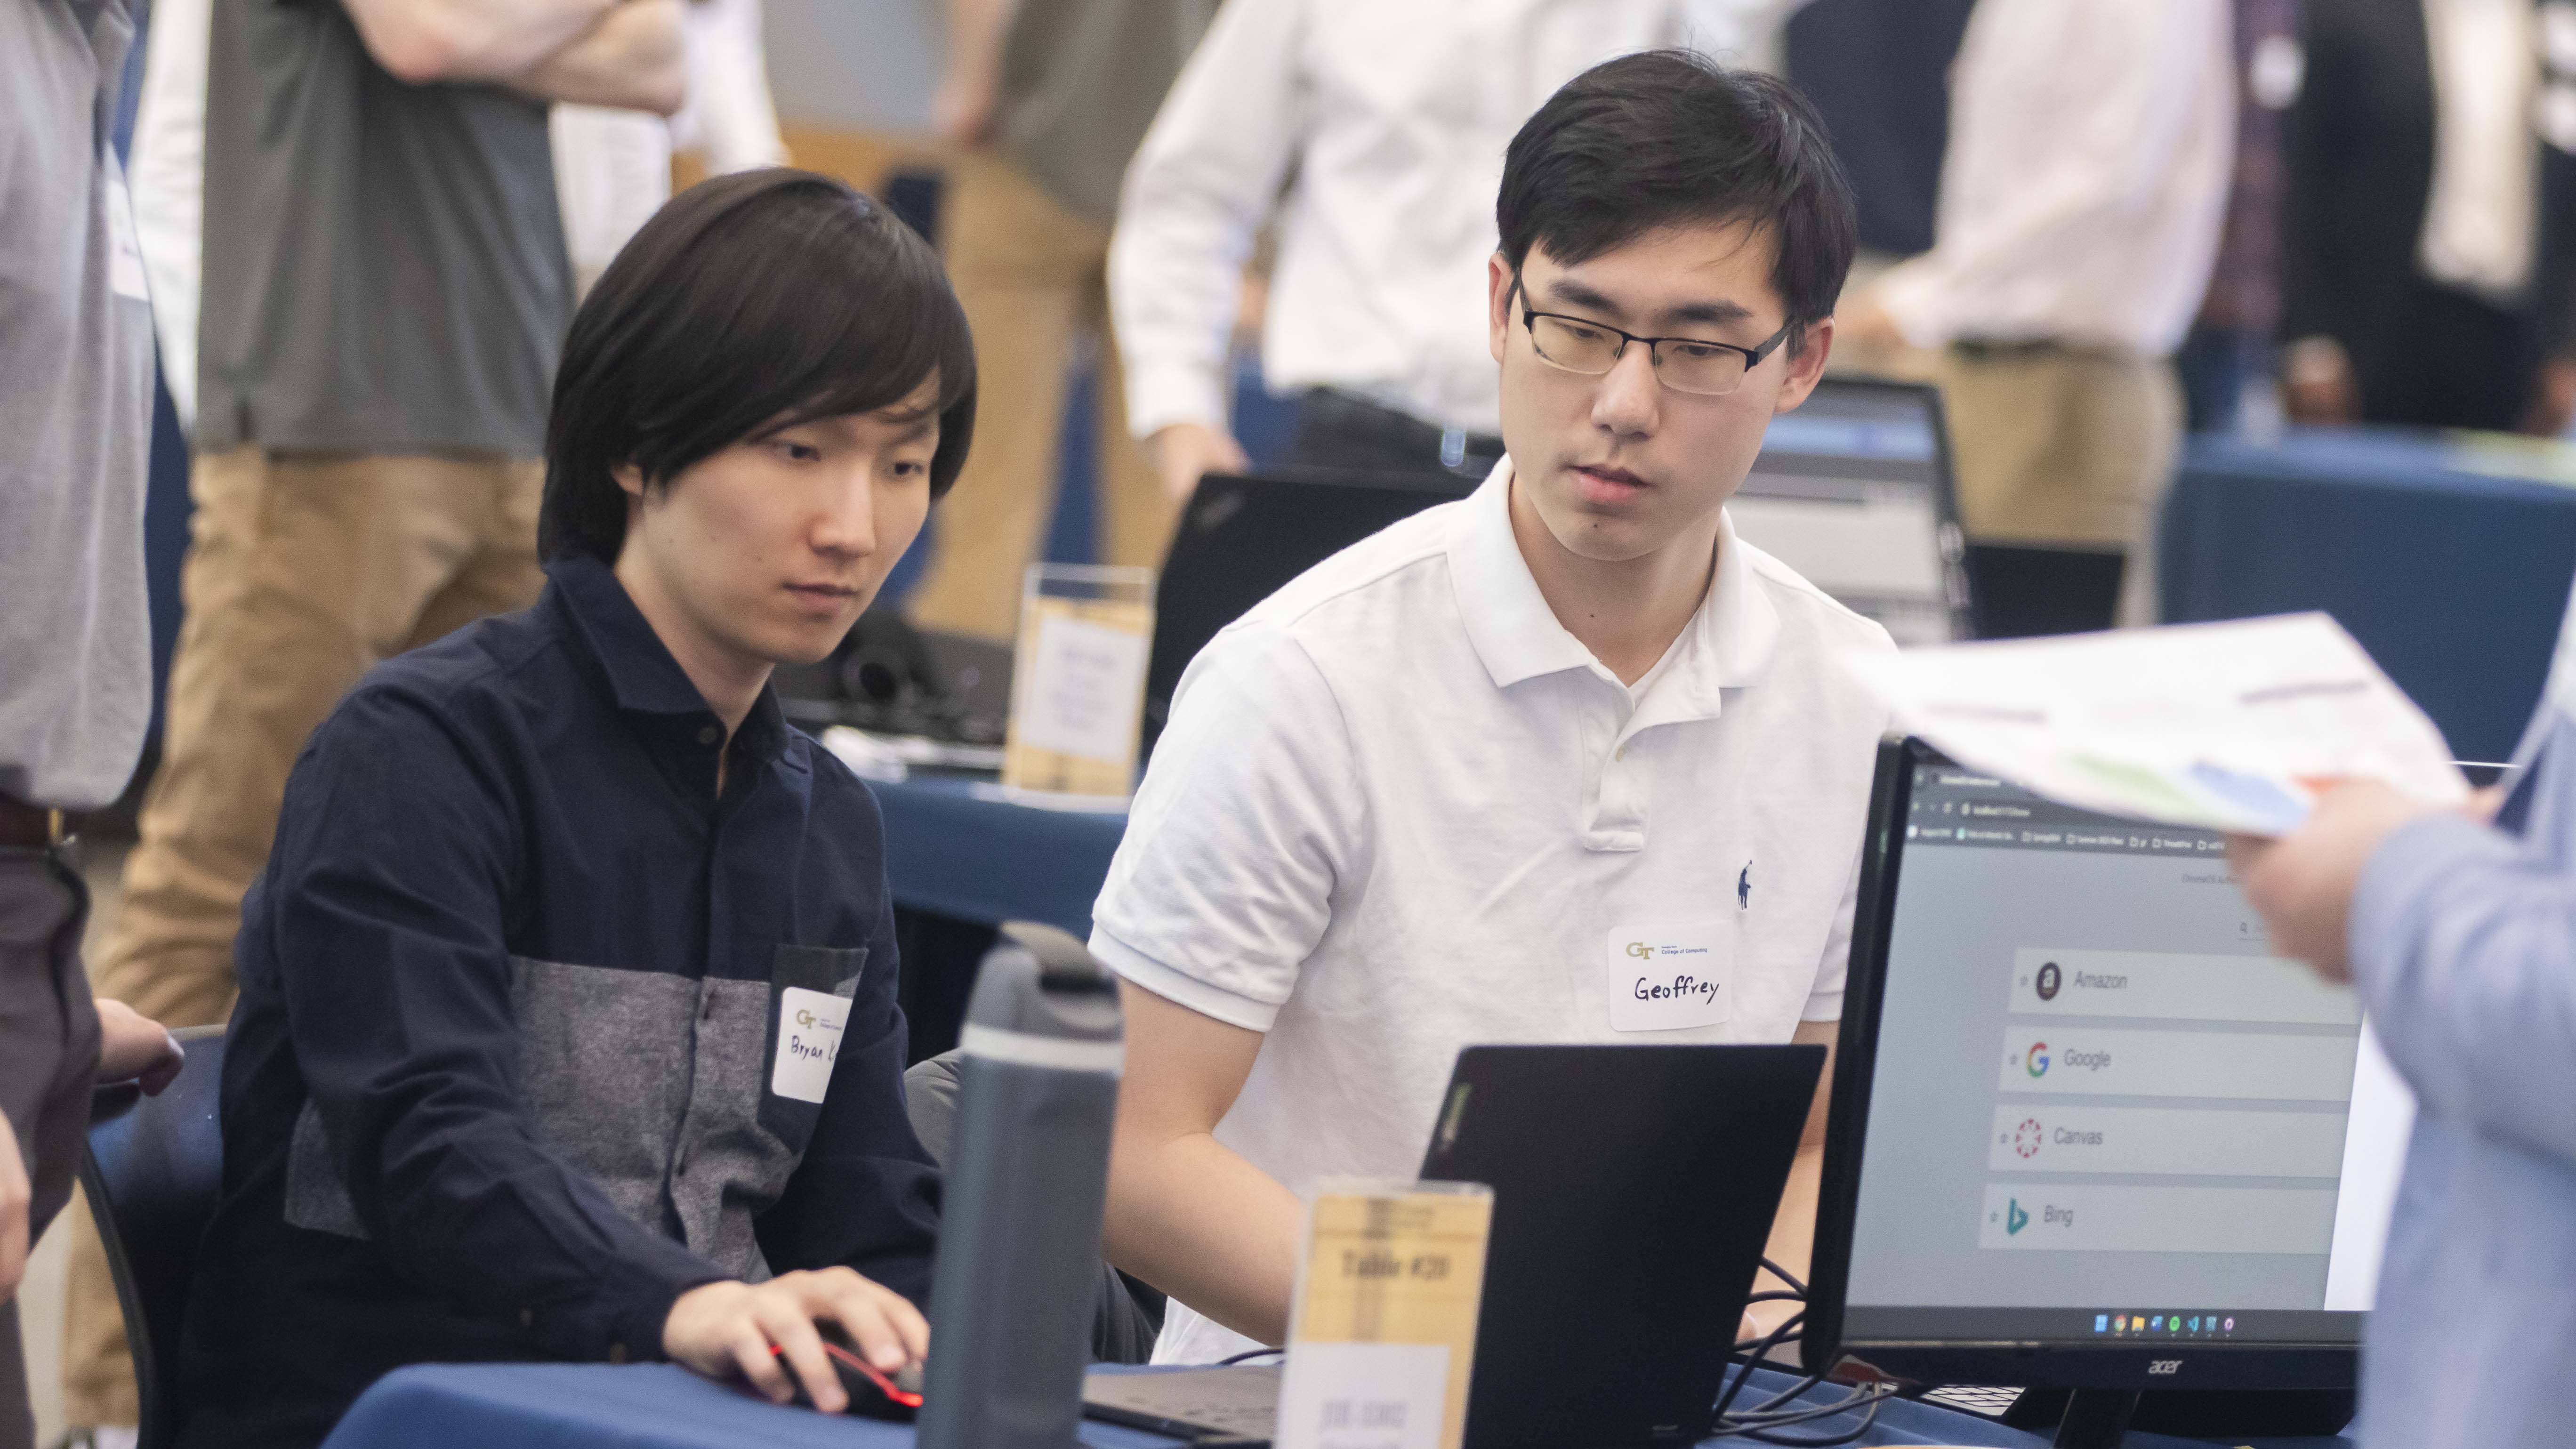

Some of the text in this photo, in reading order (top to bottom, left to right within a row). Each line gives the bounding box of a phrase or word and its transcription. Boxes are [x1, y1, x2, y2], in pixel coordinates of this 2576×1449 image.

[1626, 942, 1654, 959] GT
[1635, 975, 1719, 1005] Geoffrey
[2073, 970, 2127, 989] Amazon
[791, 1035, 823, 1061] Bryan
[2064, 1048, 2111, 1071] Google
[2054, 1126, 2102, 1144] Canvas
[2045, 1205, 2074, 1227] Bing
[1343, 1250, 1400, 1278] Table
[2148, 1360, 2184, 1374] acer
